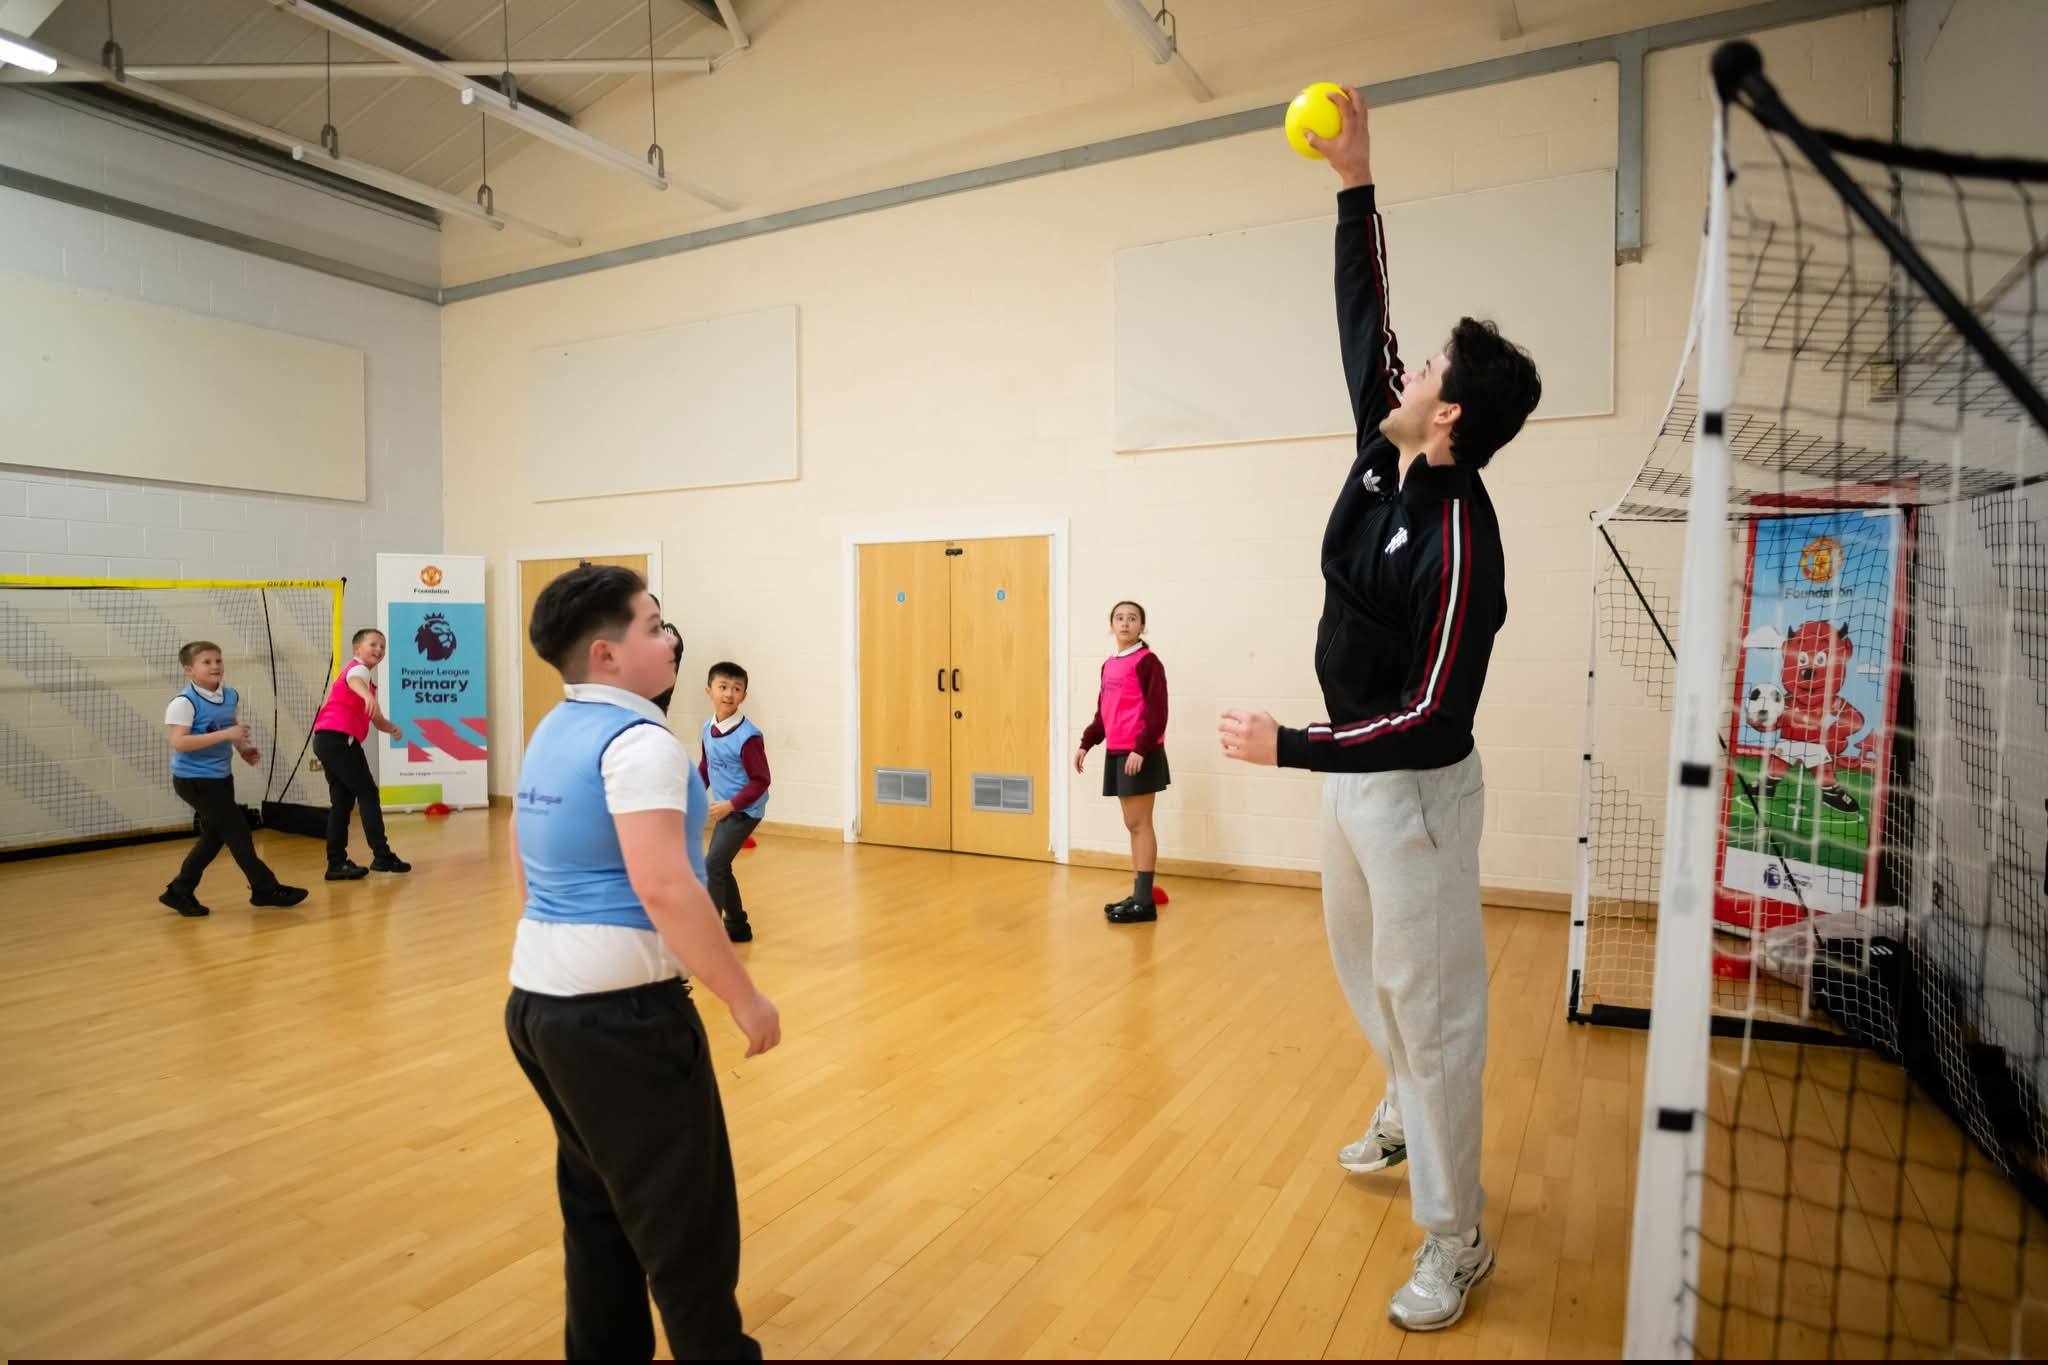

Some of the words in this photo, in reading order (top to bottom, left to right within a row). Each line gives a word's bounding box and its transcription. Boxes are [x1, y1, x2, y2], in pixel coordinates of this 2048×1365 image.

[1784, 587, 1853, 599] Foundaton
[401, 667, 434, 676] Premier
[436, 667, 470, 677] League
[401, 677, 469, 692] Primary
[415, 691, 458, 703] Stars
